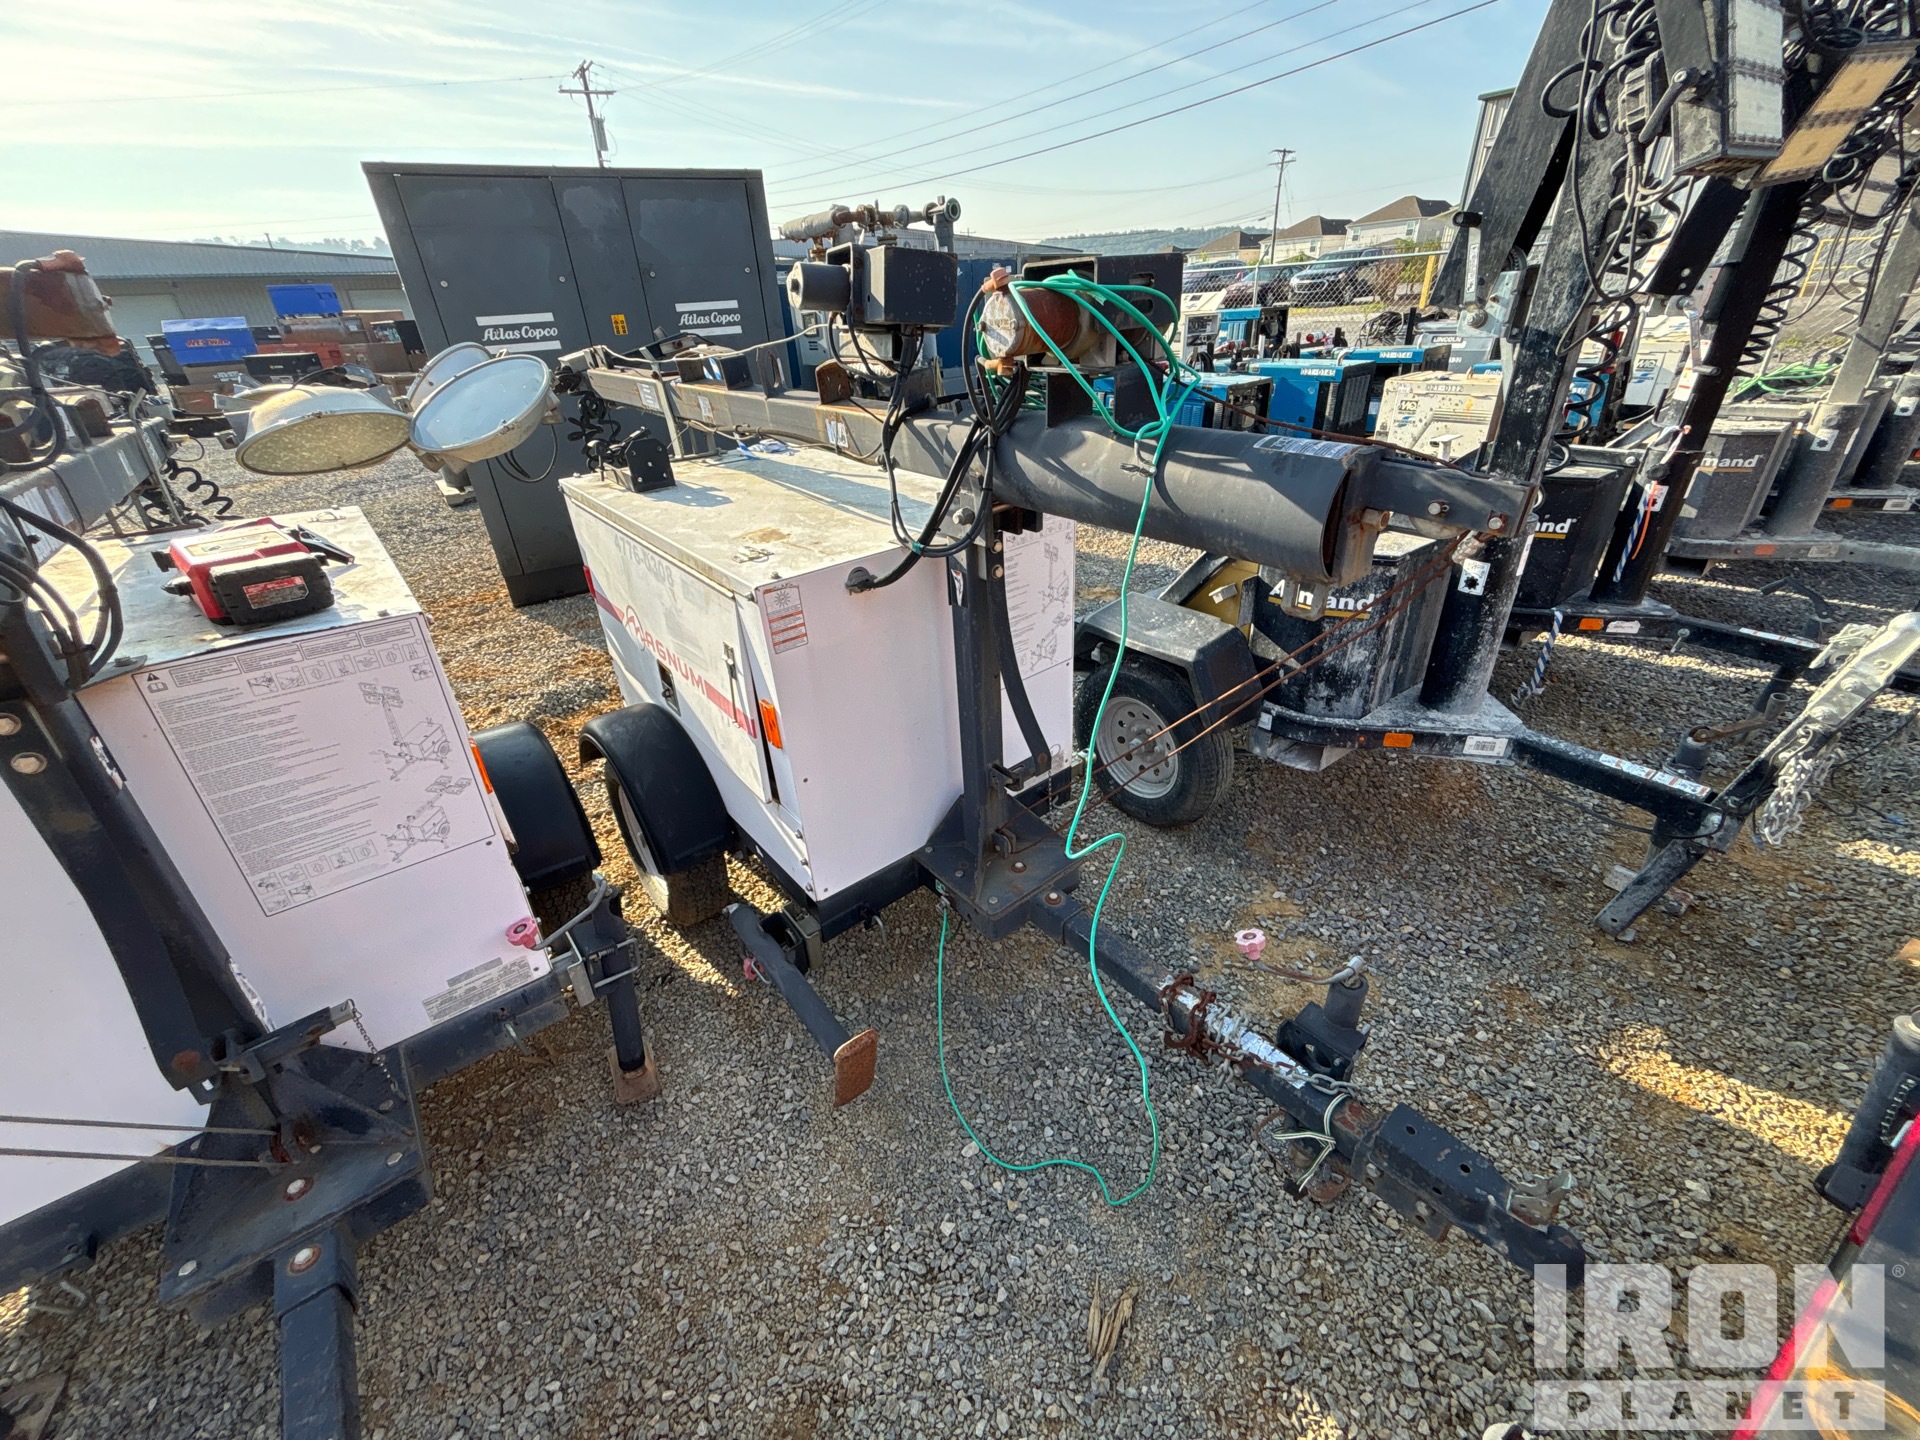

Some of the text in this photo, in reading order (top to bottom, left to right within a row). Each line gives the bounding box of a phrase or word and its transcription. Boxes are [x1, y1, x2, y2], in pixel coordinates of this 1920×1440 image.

[678, 312, 741, 326] Atlas Copco
[482, 325, 559, 341] Atlas Copco
[1636, 359, 1658, 369] MQ
[1425, 384, 1464, 393] 021-0112
[1398, 400, 1419, 412] MQ
[615, 533, 675, 588] 4776-0308
[1268, 578, 1376, 612] Amand
[625, 605, 706, 696] MAGNUM
